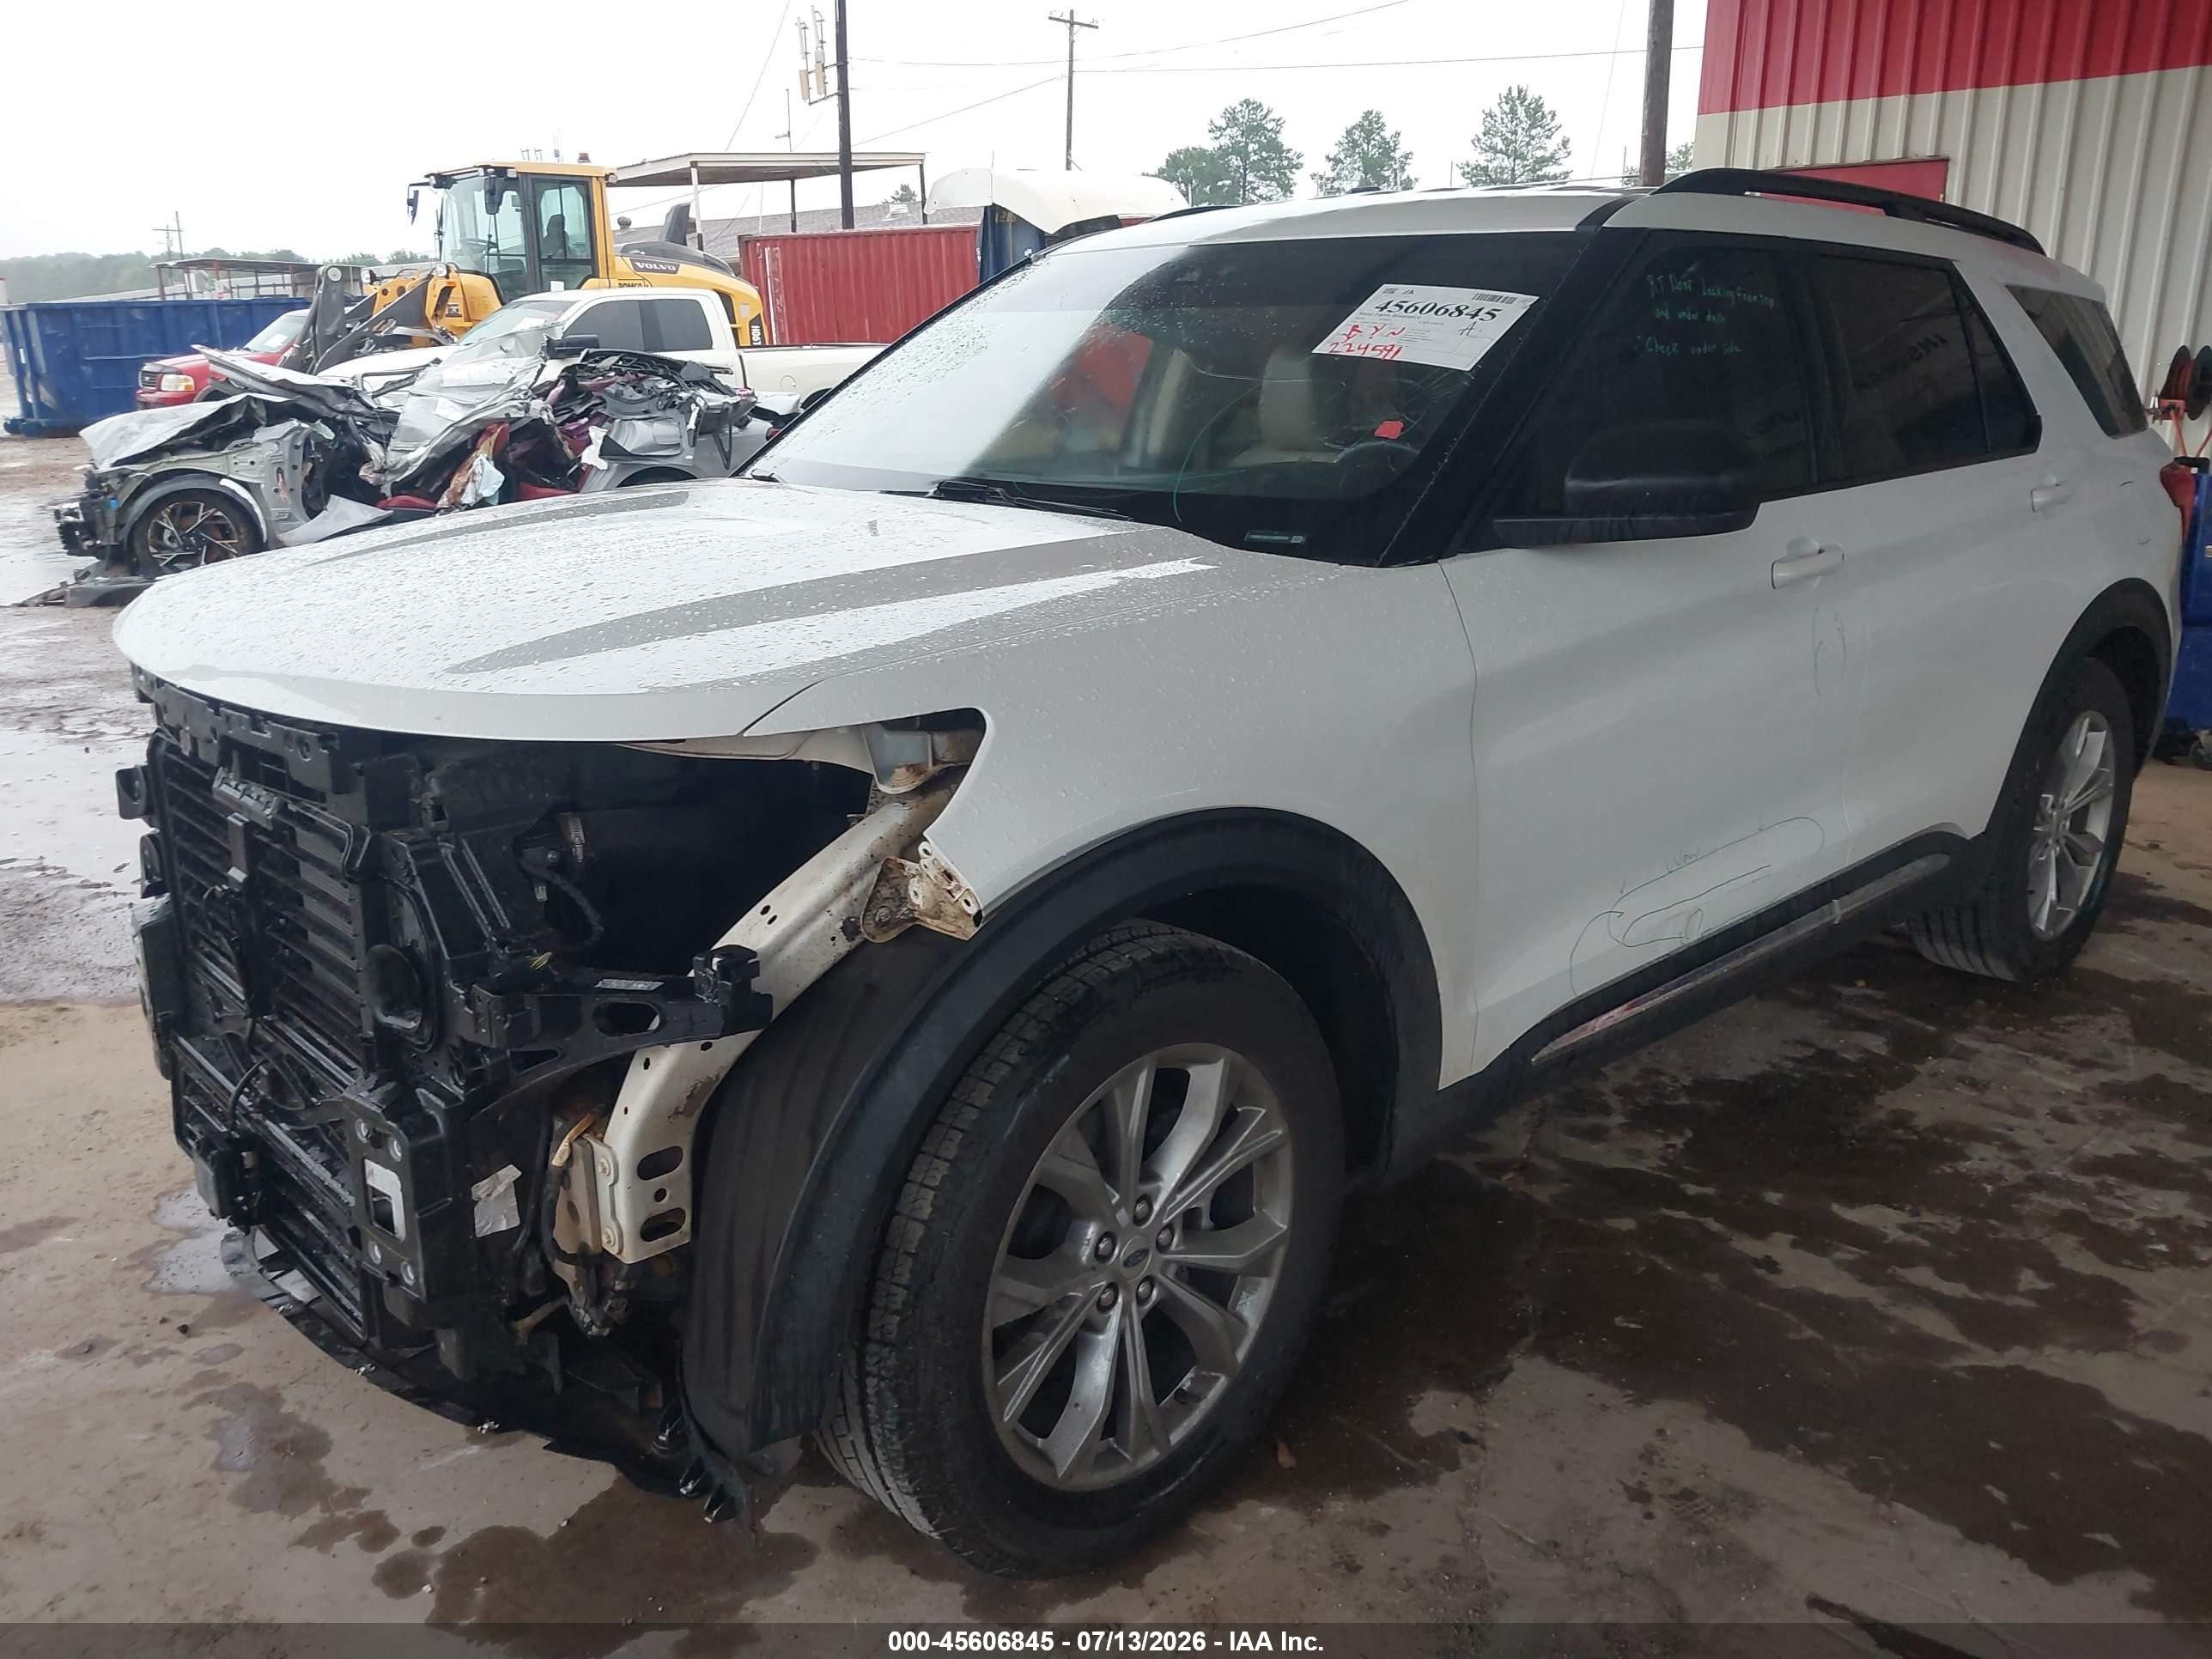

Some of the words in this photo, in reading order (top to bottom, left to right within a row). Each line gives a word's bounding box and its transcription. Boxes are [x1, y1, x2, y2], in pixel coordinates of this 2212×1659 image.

[635, 261, 677, 271] VOLVO
[1374, 300, 1504, 322] 45606845
[1645, 336, 1679, 356] Check
